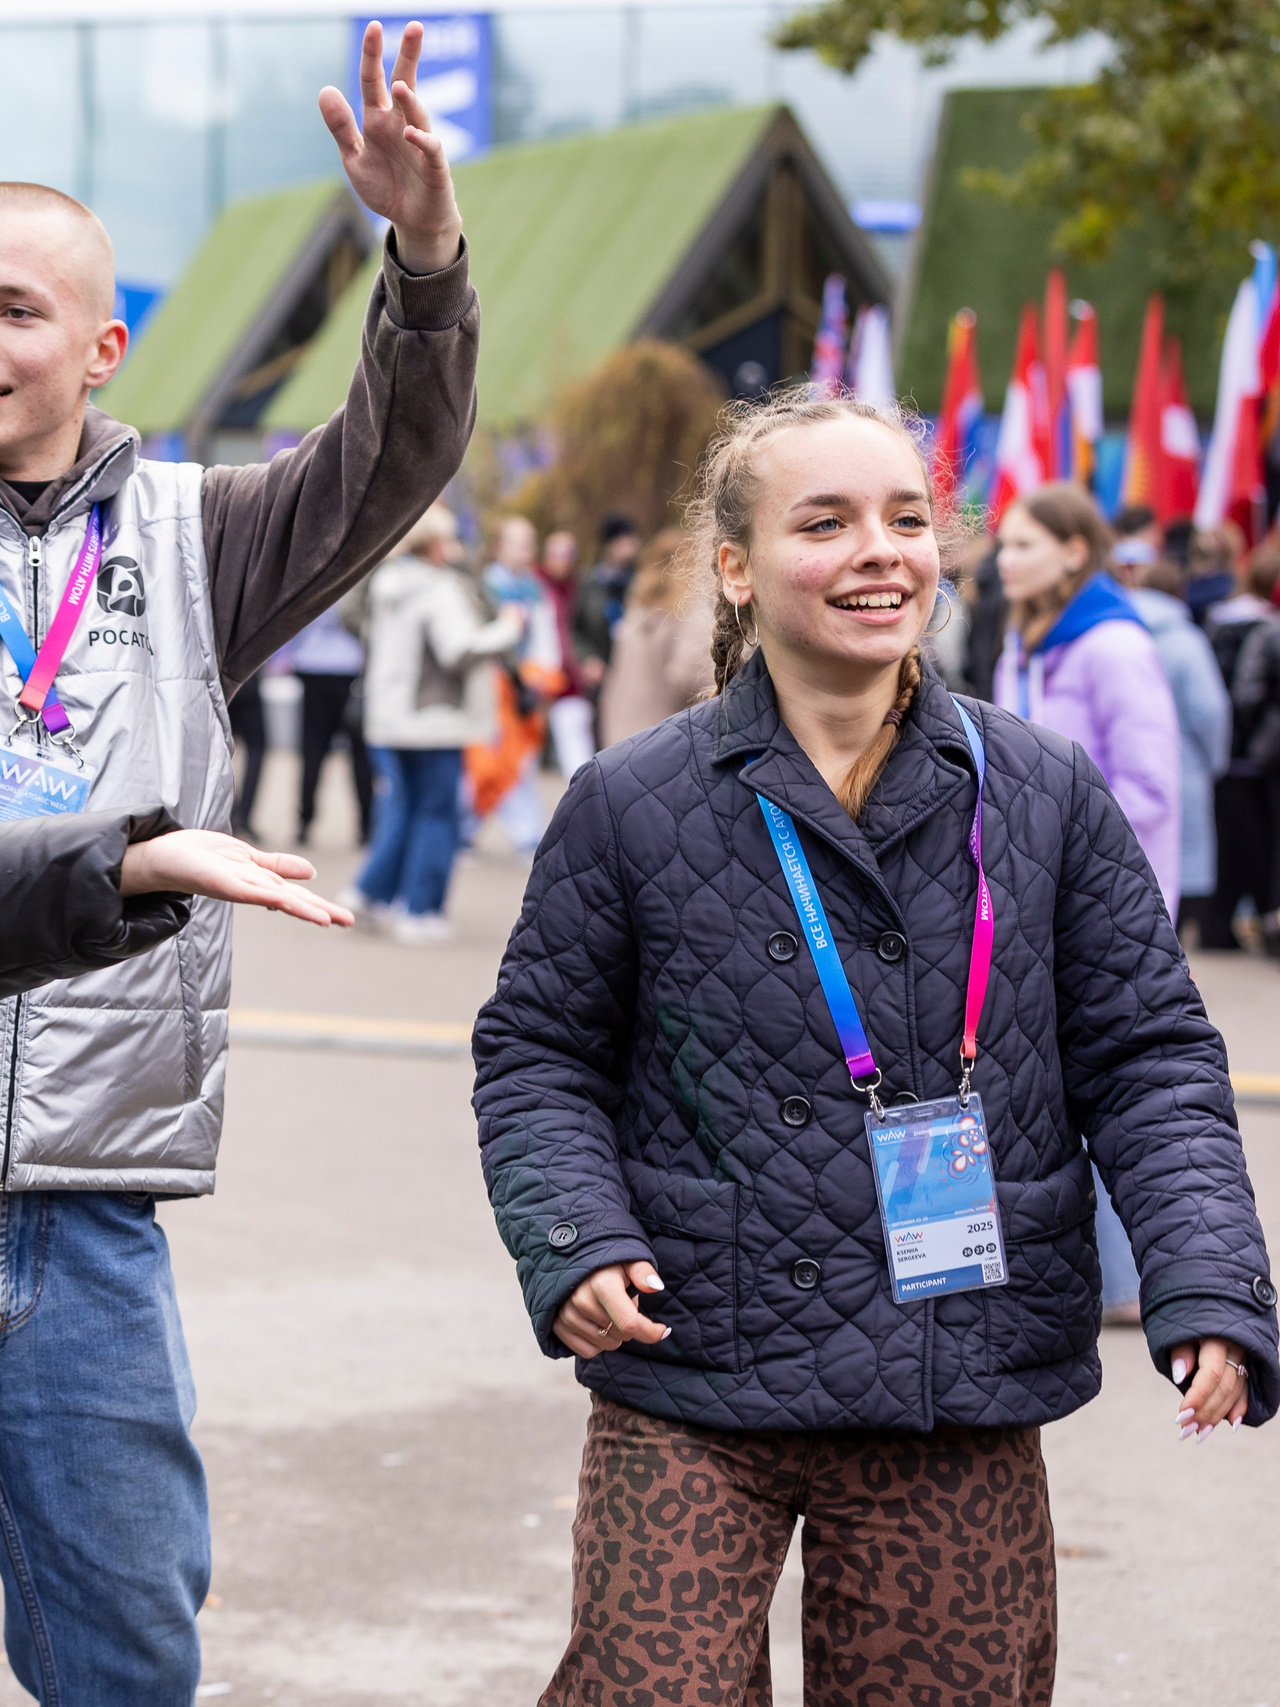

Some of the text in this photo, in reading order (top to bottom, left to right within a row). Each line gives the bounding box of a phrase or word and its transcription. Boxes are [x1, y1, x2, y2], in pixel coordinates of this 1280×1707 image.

[80, 554, 96, 577] WITH
[68, 578, 87, 605] ATOM
[88, 630, 154, 655] РОСАТО
[1, 759, 78, 800] WAW
[782, 843, 818, 923] НАЧИНАЕТСЯ
[981, 884, 989, 921] ATOM
[810, 923, 828, 949] ВСЕ
[877, 1130, 906, 1143] WAW
[894, 1231, 924, 1243] WAW
[967, 1221, 993, 1234] 2025
[901, 1277, 946, 1292] PARTICIPANT
